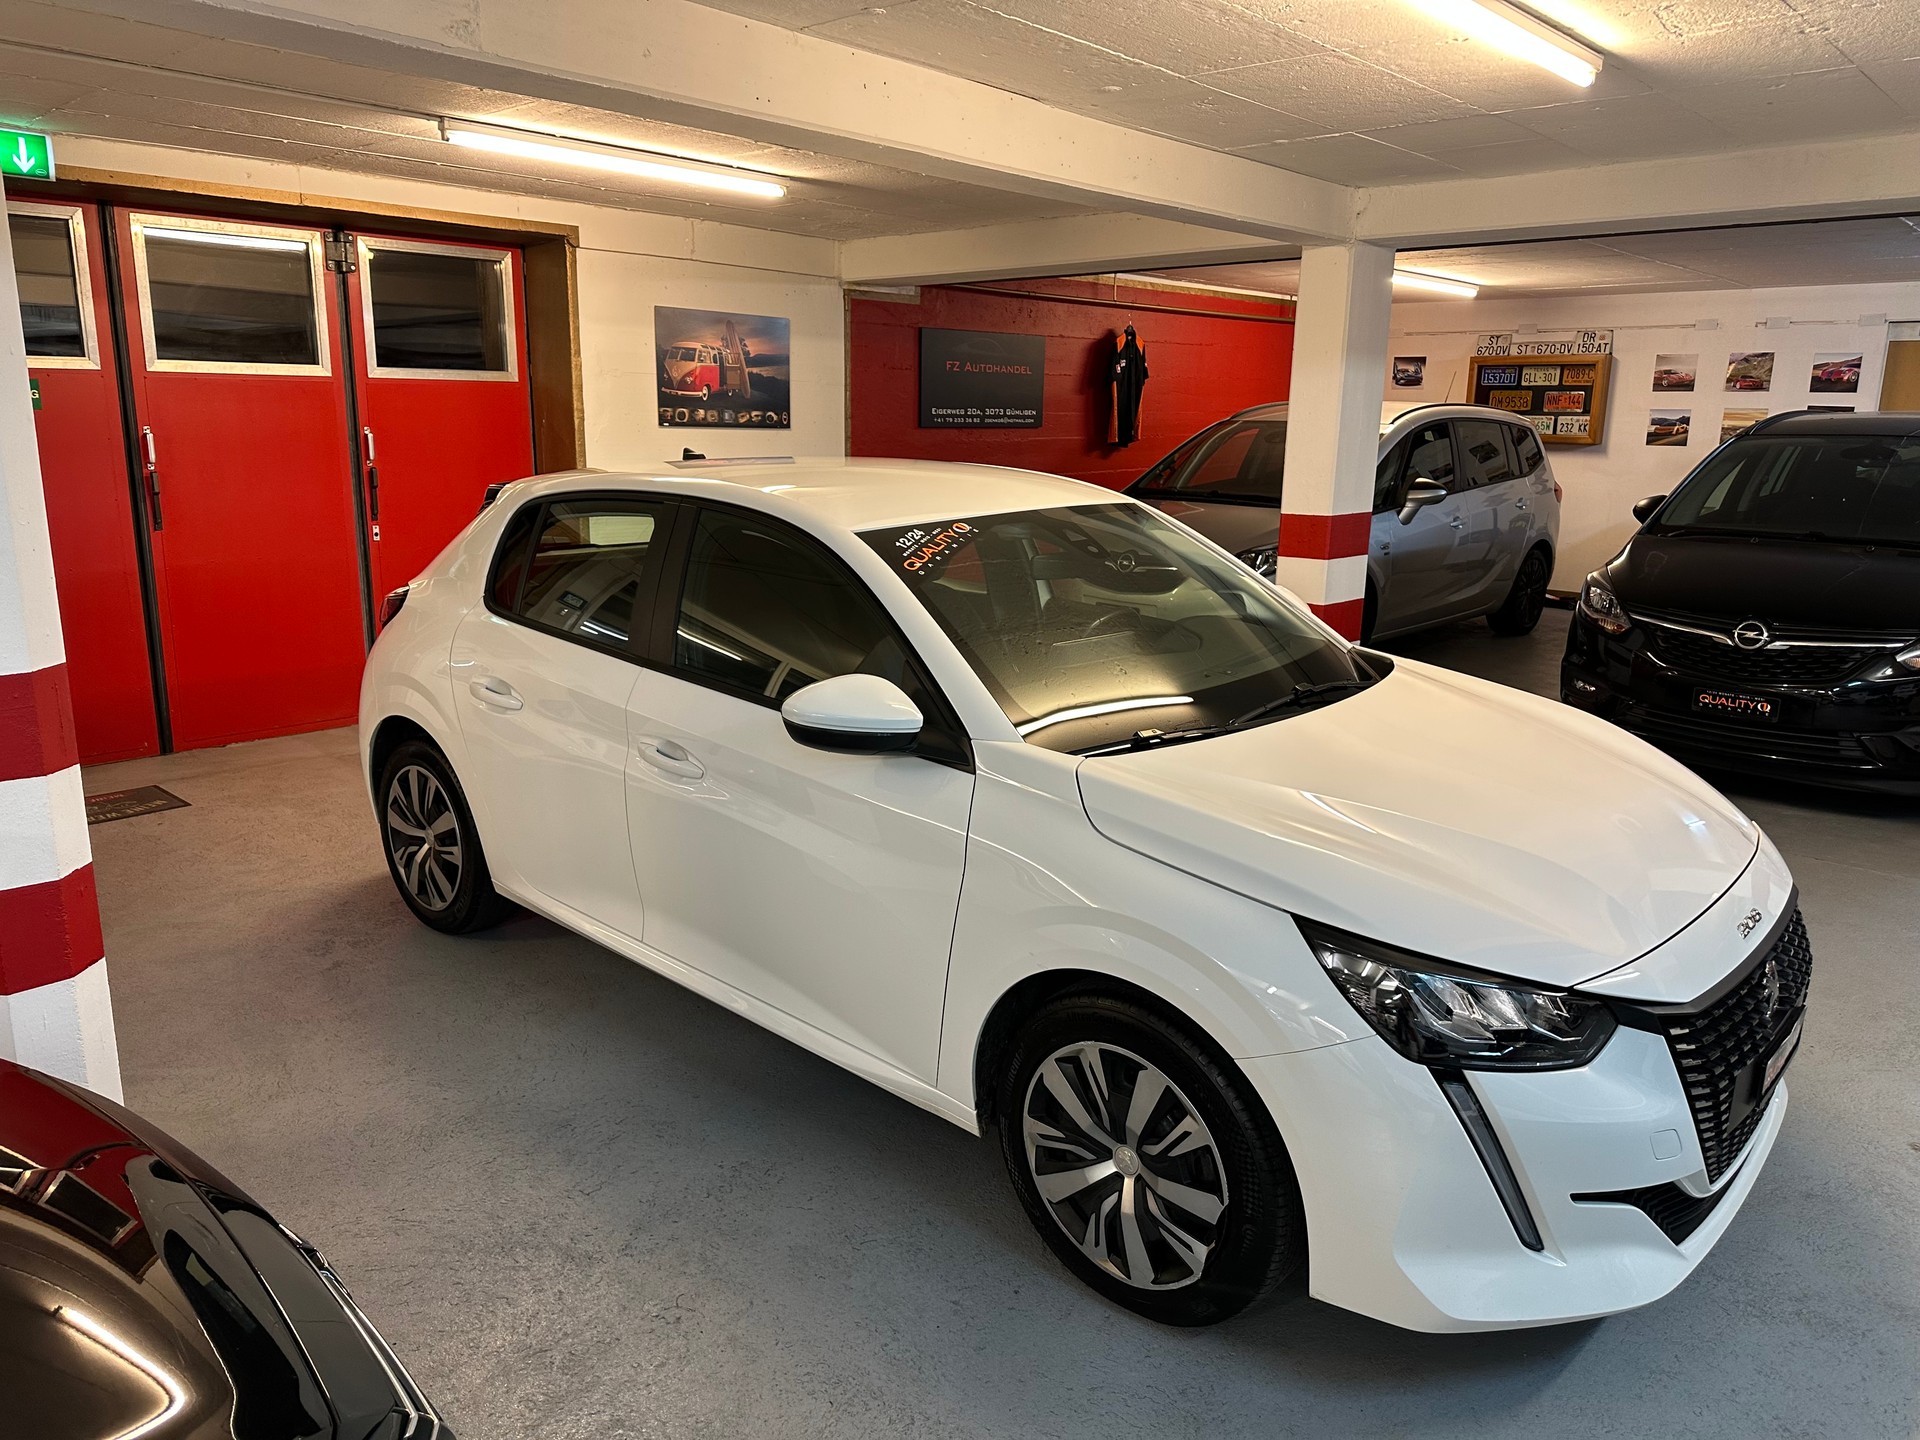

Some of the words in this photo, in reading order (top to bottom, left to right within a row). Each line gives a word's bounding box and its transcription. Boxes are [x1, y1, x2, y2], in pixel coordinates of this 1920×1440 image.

[1488, 335, 1500, 346] ST
[1582, 332, 1597, 343] DR
[1516, 343, 1530, 355] ST
[946, 361, 960, 372] FZ
[985, 408, 1004, 416] 3073
[895, 528, 926, 549] 12/24
[903, 528, 959, 571] QUALITY
[1699, 694, 1757, 710] QUALITY
